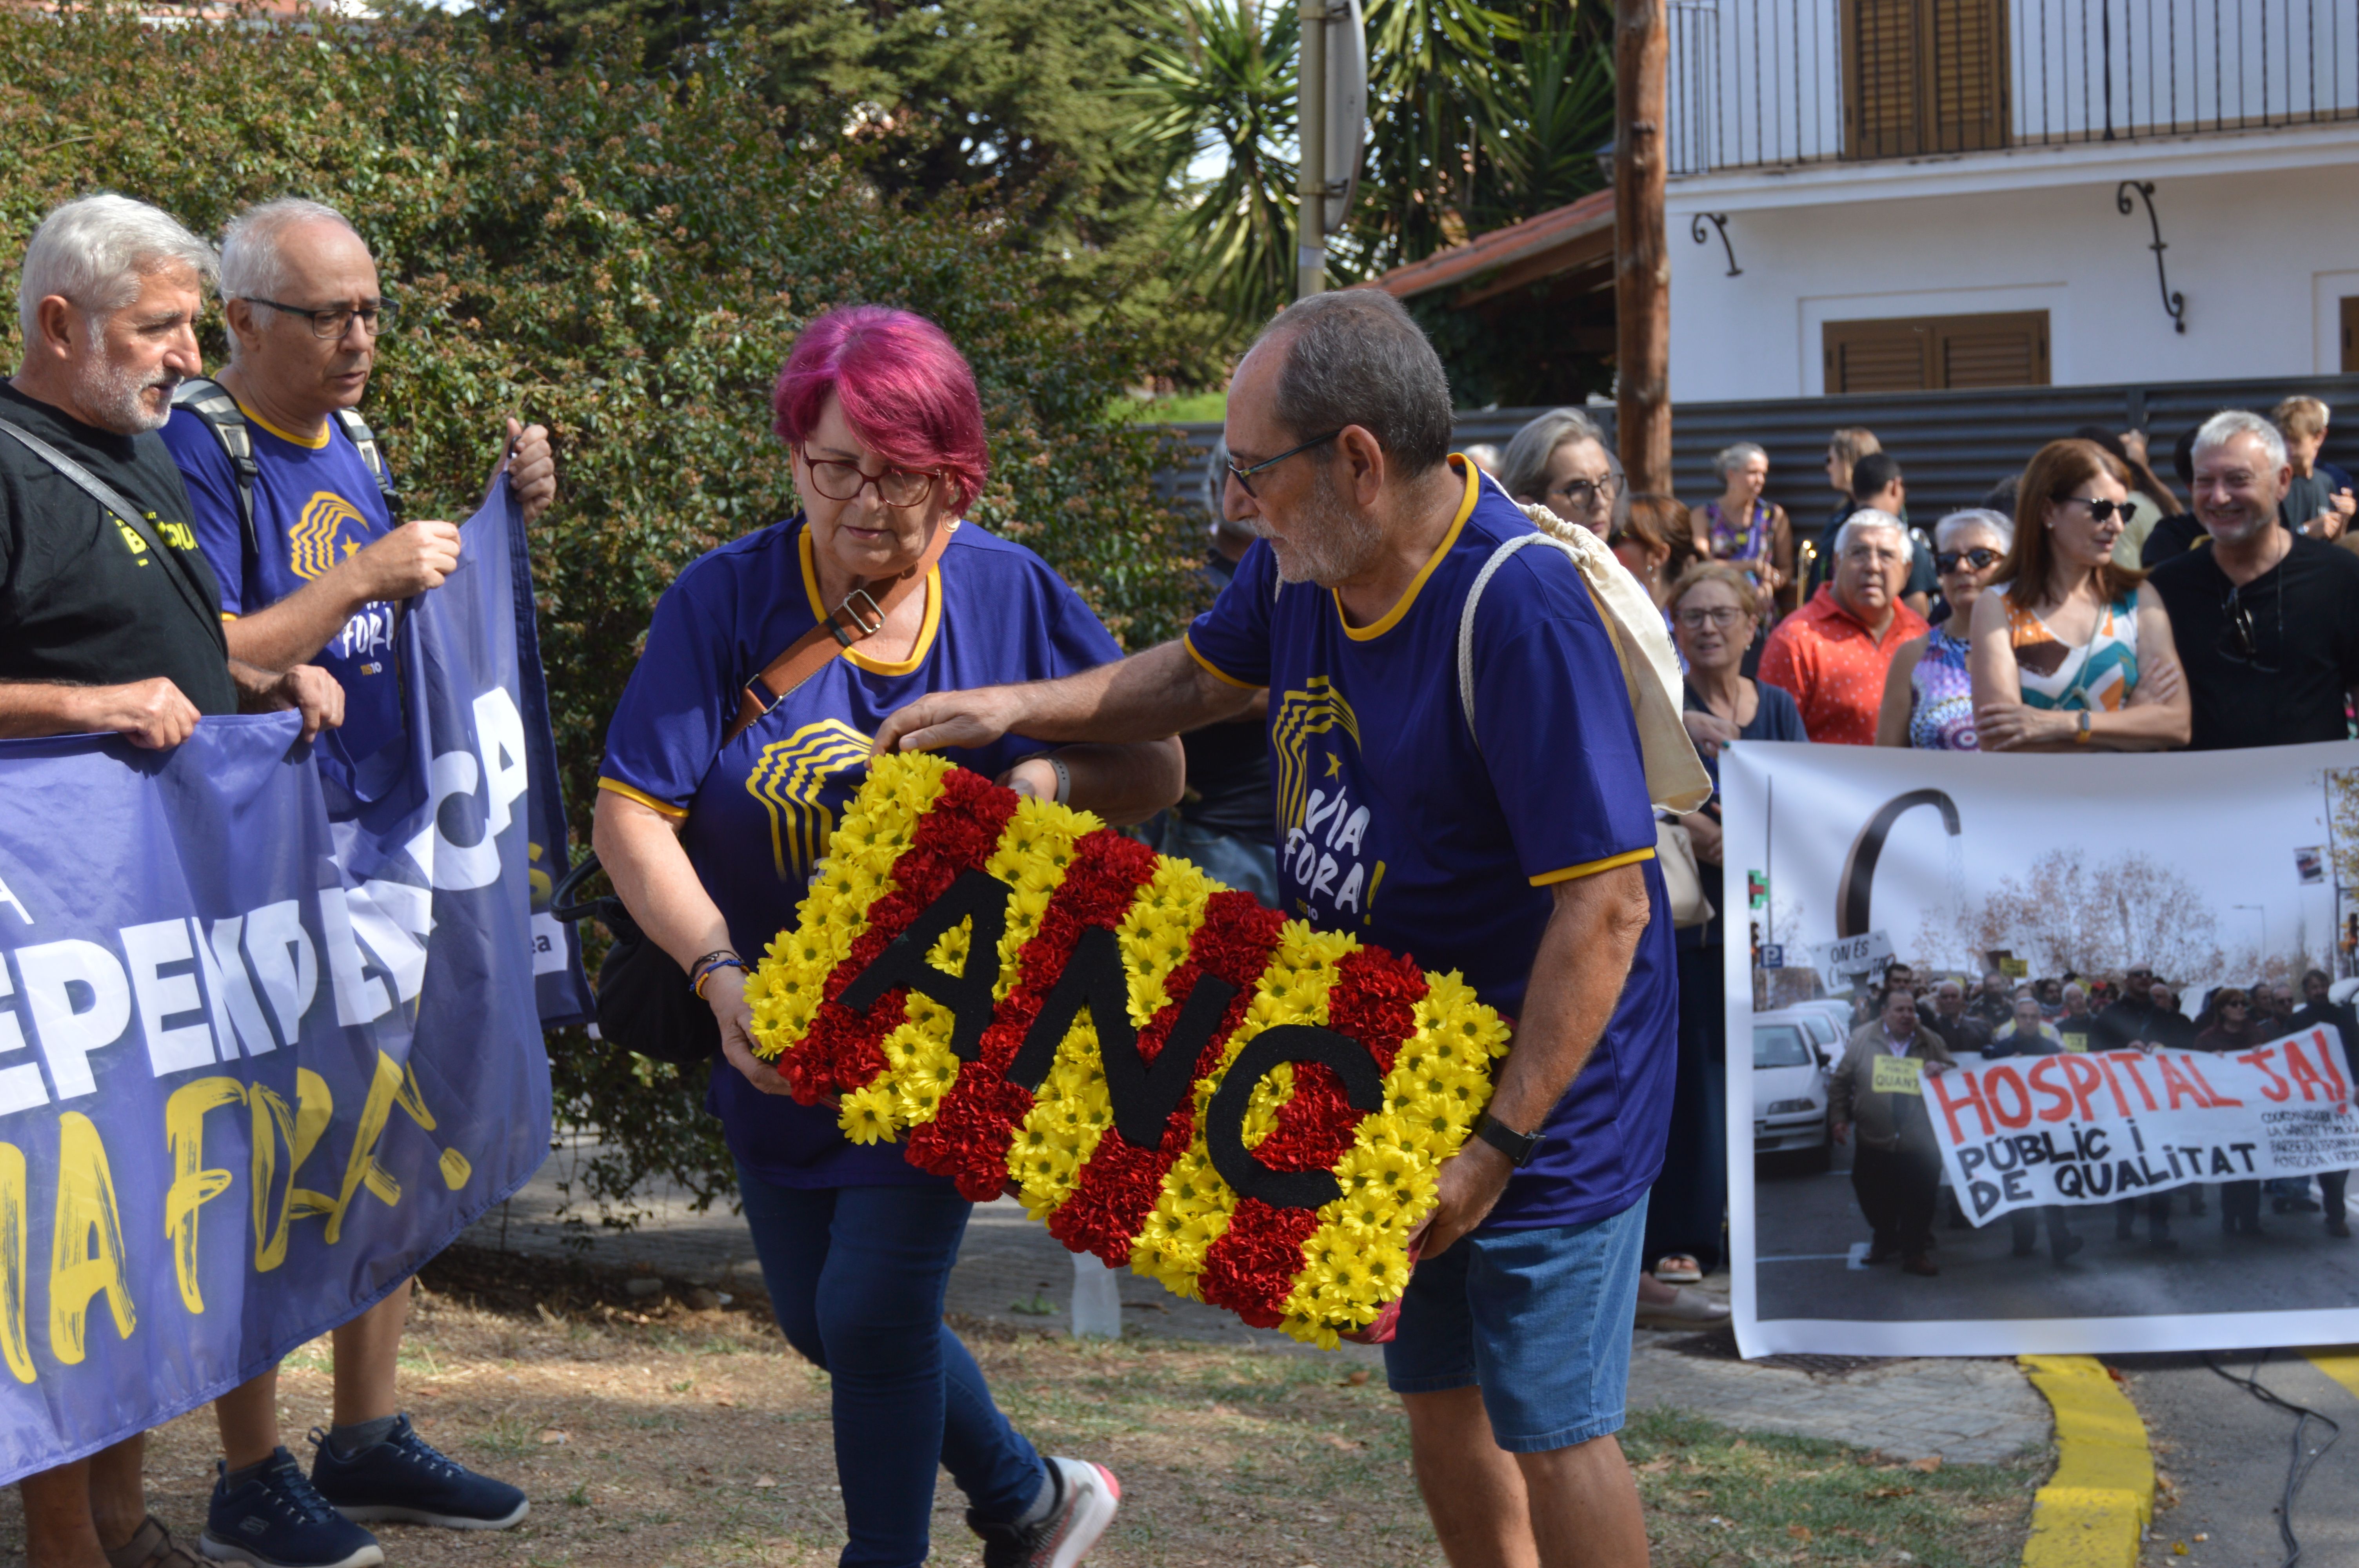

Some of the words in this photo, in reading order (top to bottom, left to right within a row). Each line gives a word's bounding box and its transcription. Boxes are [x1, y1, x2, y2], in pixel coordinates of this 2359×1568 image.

[1305, 785, 1370, 856] VIA
[1284, 828, 1386, 925] FORA!
[1763, 946, 1780, 965] P
[1831, 944, 1851, 964] ON
[835, 869, 1383, 1209] ANC
[2237, 1029, 2348, 1115] JA!
[1968, 1169, 2034, 1219] DE
